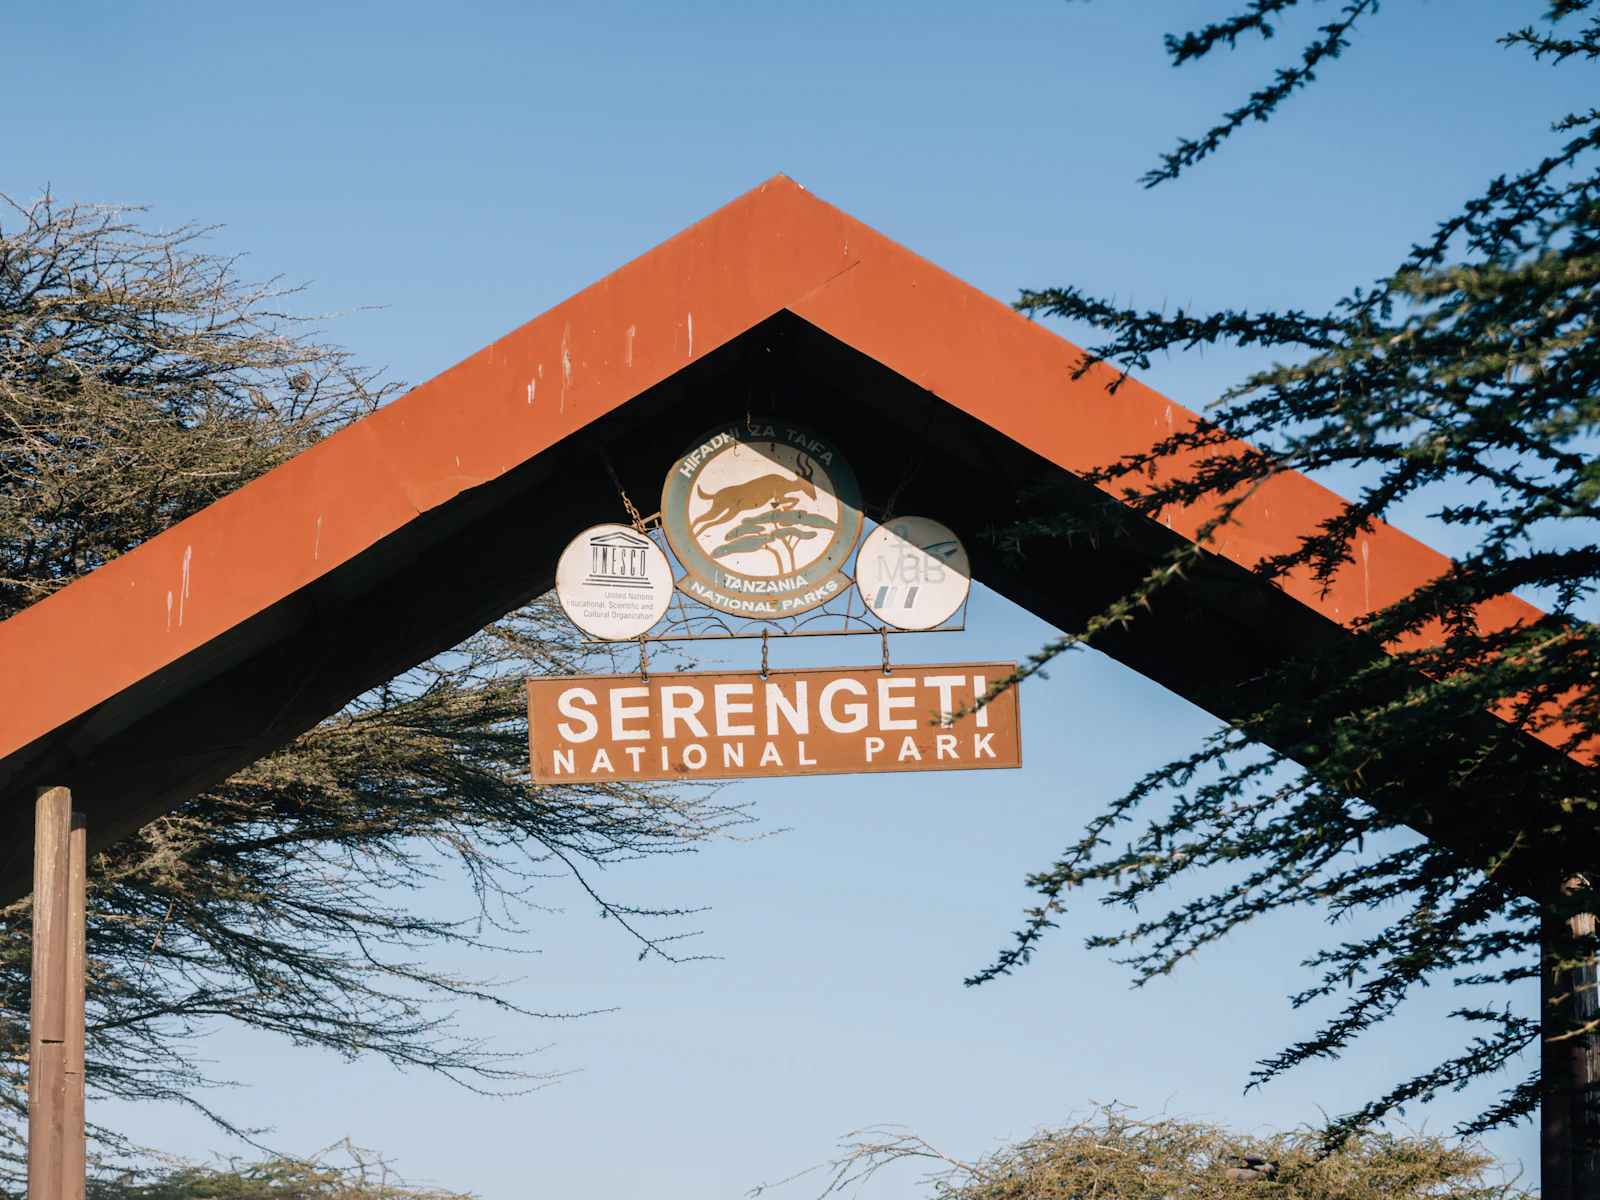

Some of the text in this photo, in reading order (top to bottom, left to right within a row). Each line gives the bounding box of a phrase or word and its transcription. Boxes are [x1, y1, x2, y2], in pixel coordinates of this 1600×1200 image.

[679, 424, 834, 478] HIFADHI ZA TAIFA
[592, 547, 646, 577] UNESCO
[628, 592, 654, 601] Nations
[691, 580, 838, 613] NATIONAL PARKS
[724, 573, 809, 593] TANZANIA
[583, 610, 654, 620] Cultural Organization
[608, 601, 639, 610] Scientific
[557, 675, 988, 743] SERENGETI
[553, 732, 997, 774] NATIONAL PARK
